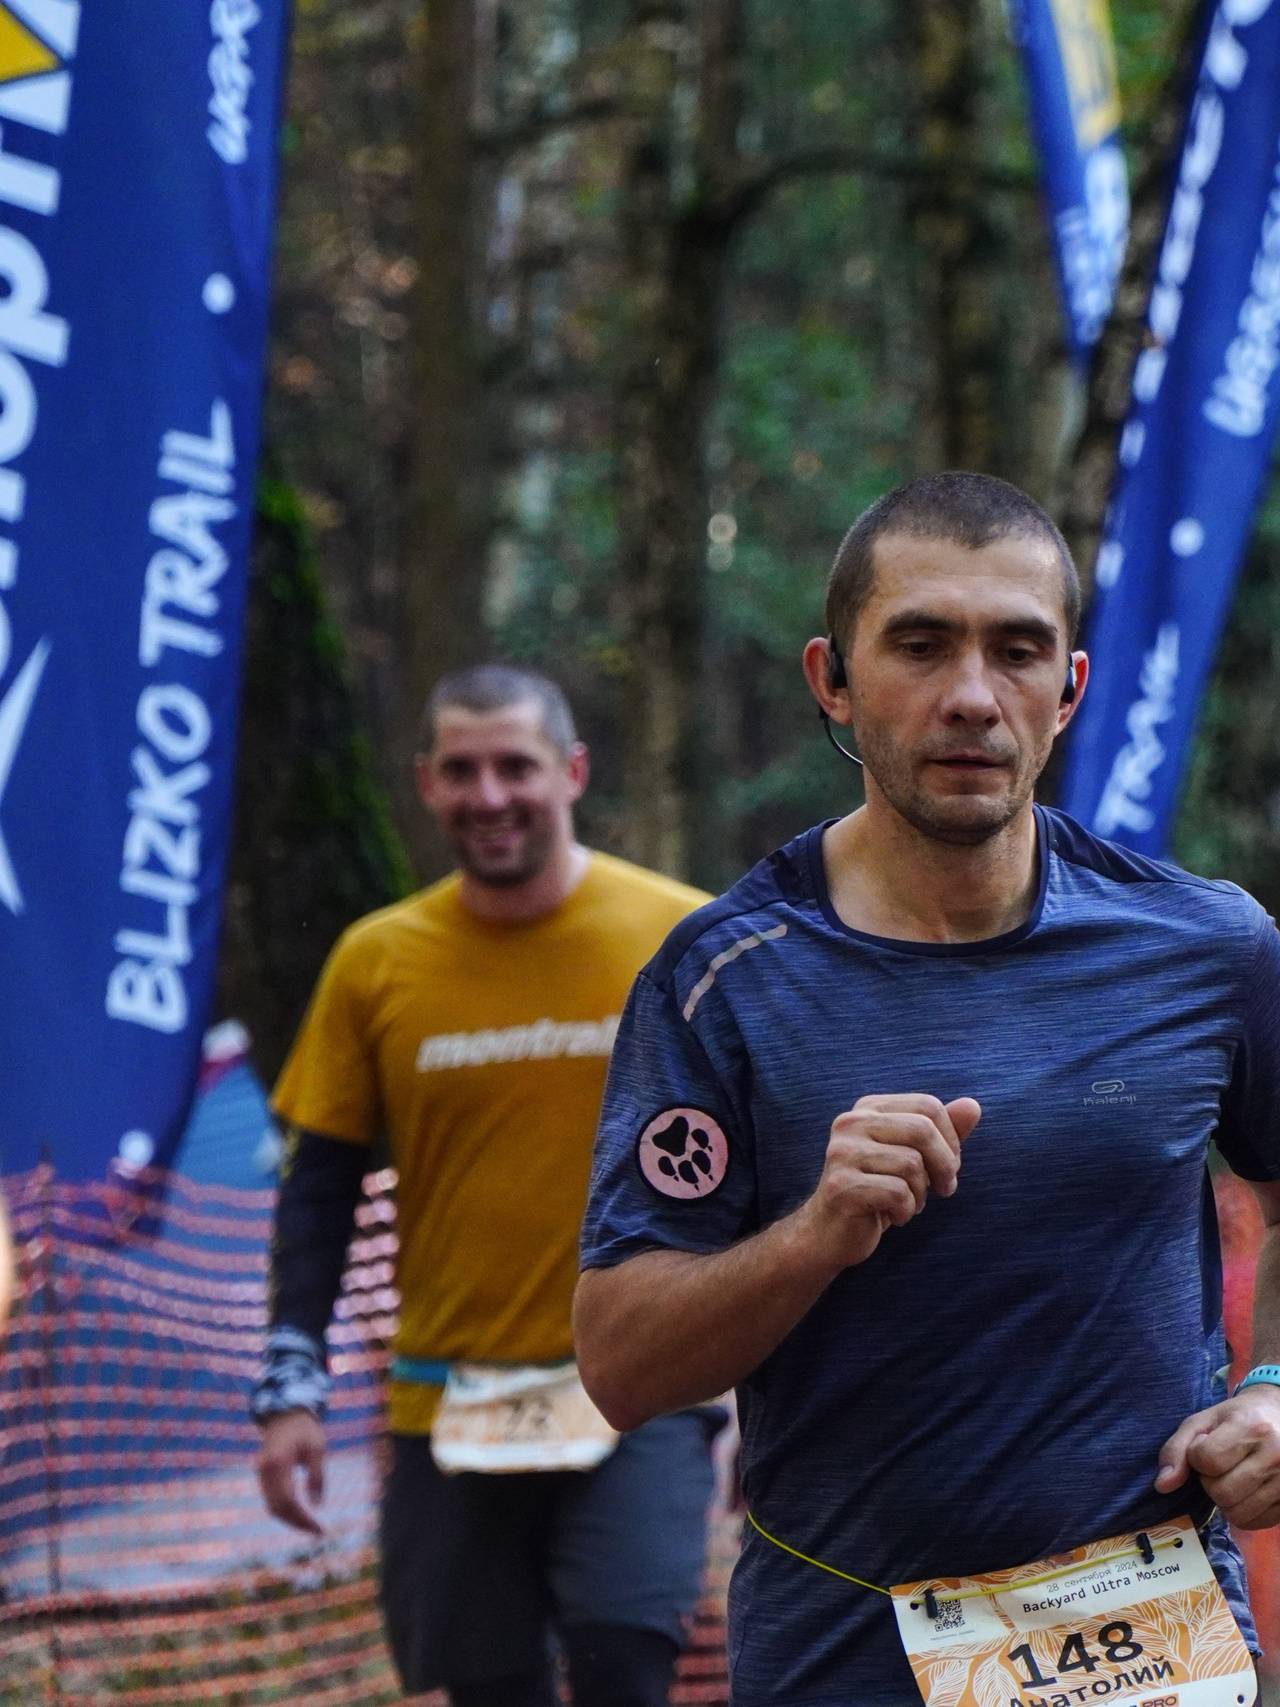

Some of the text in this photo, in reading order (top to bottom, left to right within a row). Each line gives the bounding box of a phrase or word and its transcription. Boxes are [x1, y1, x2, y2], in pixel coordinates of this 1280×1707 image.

[105, 396, 238, 1036] BLIZKO TRAIL
[1023, 1563, 1181, 1613] Backyard Ultra Moscow
[1046, 1560, 1138, 1594] 28 сентября 2024
[1007, 1620, 1144, 1690] 148
